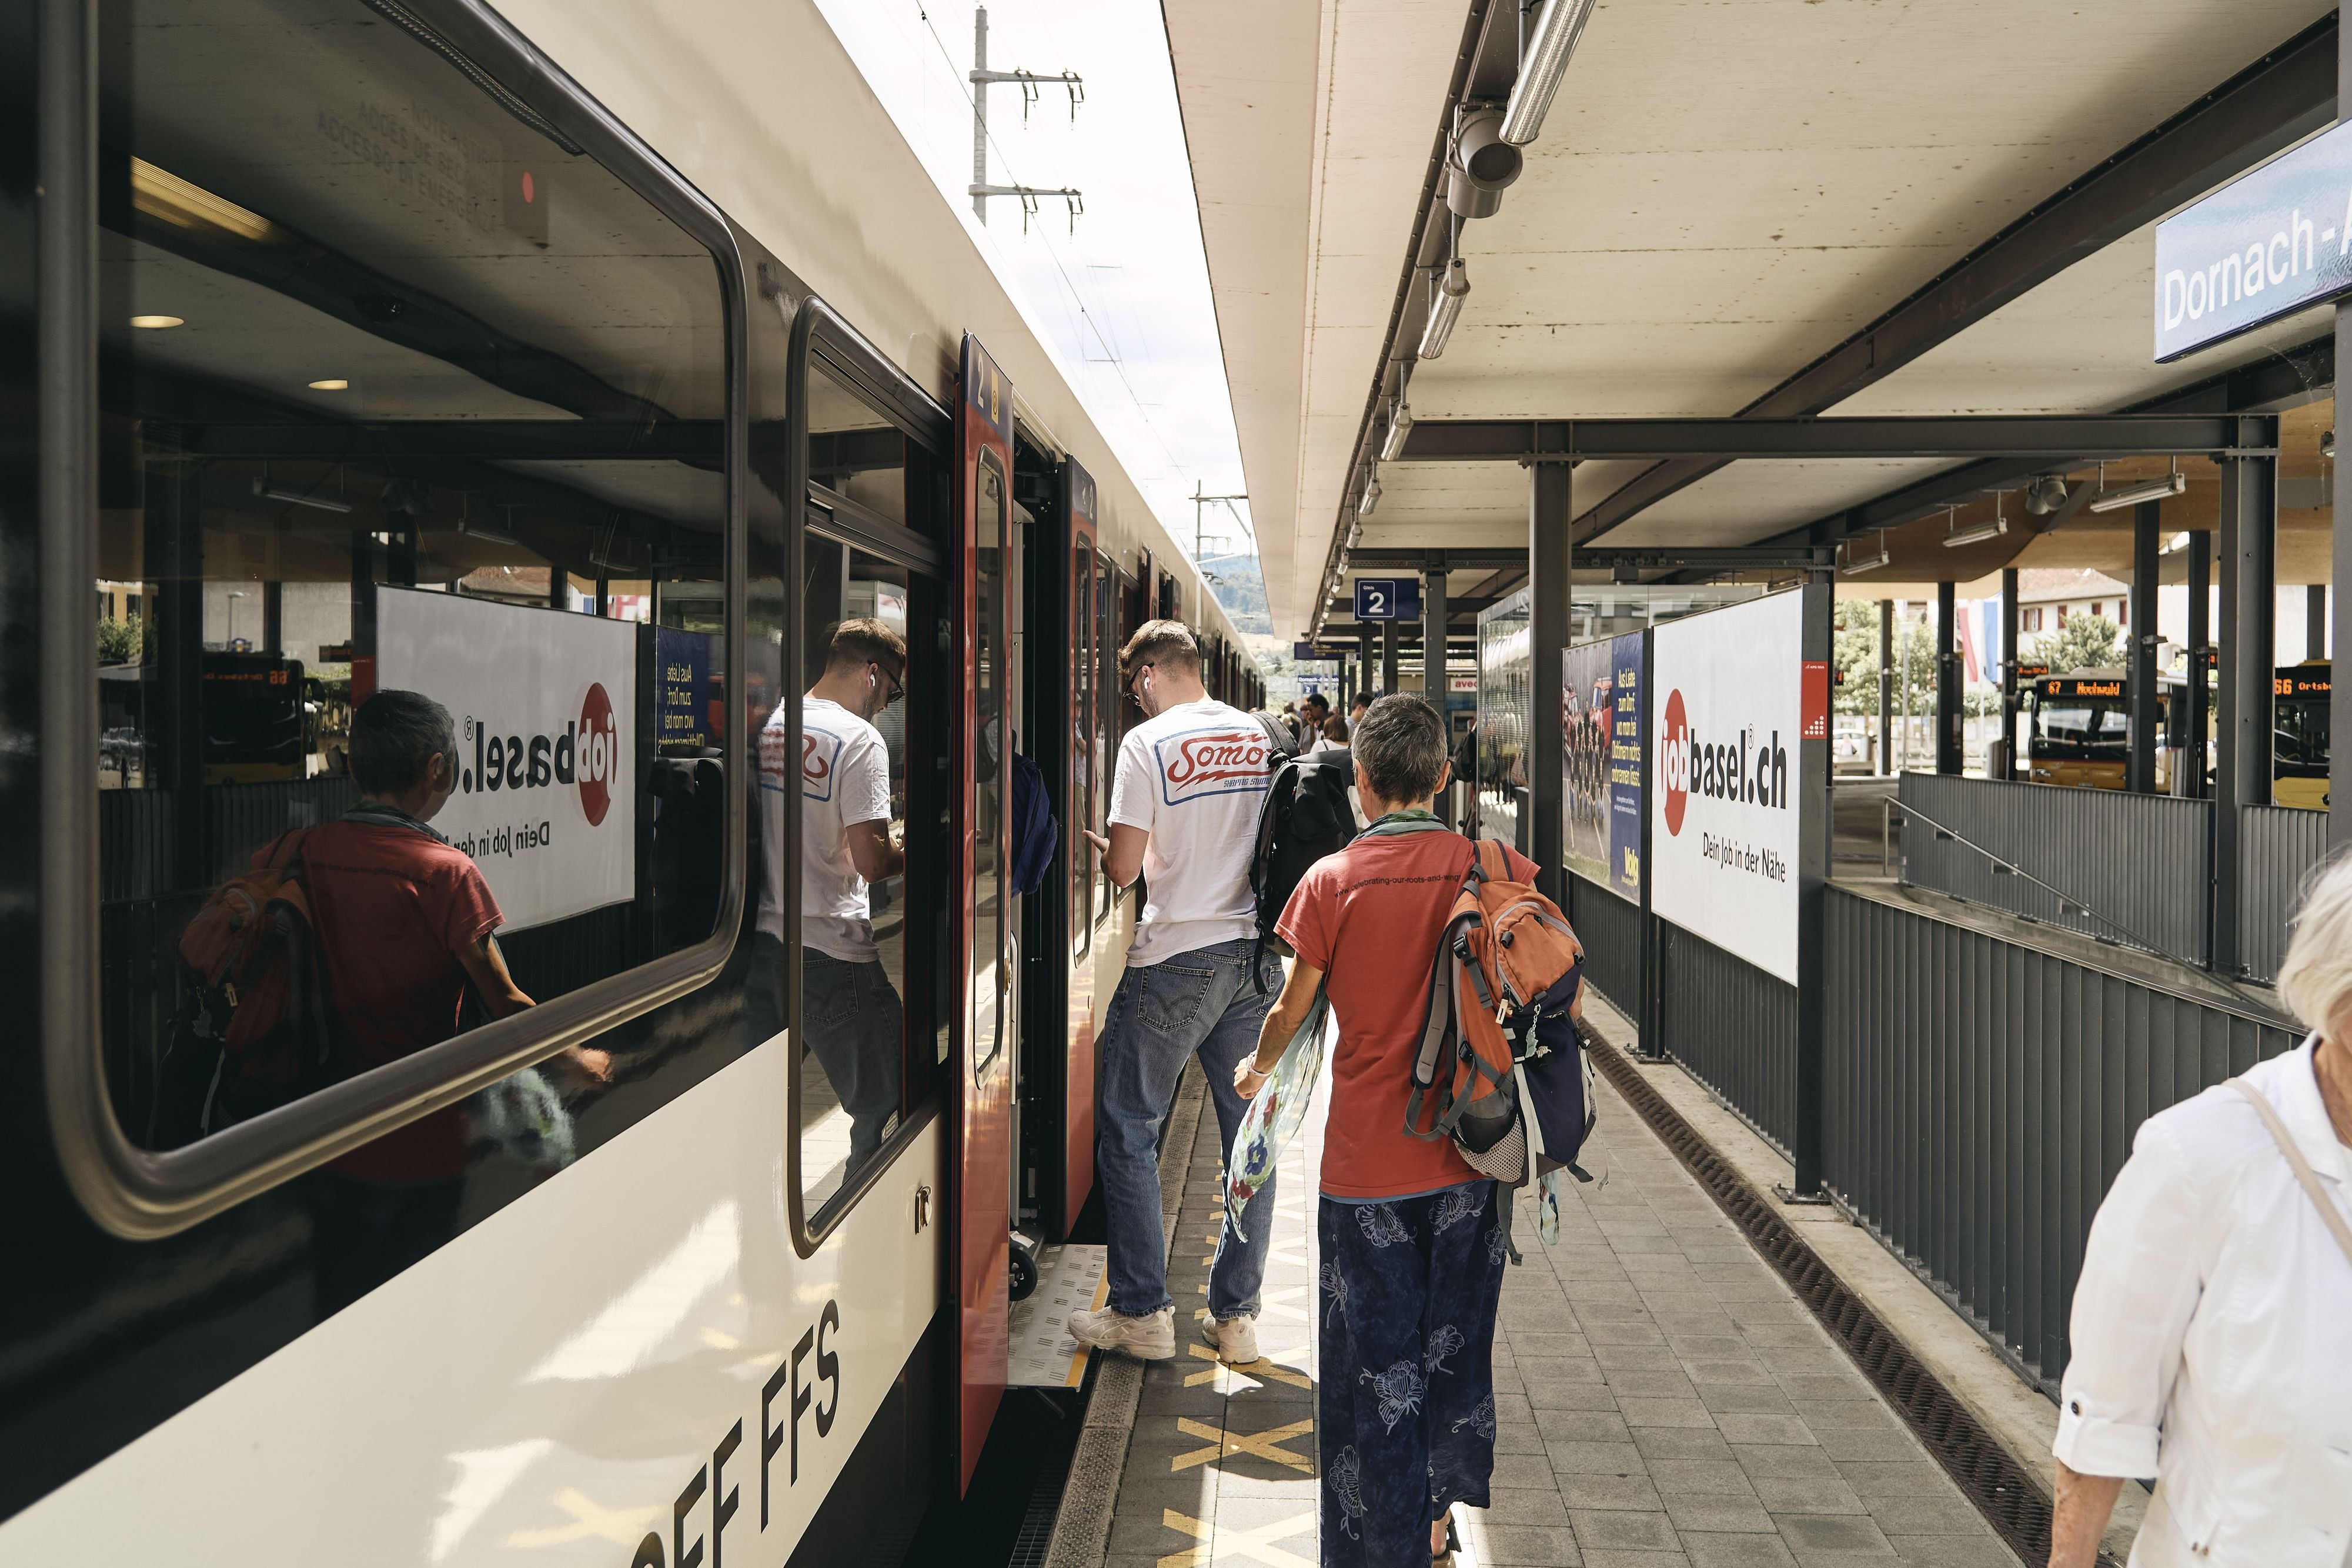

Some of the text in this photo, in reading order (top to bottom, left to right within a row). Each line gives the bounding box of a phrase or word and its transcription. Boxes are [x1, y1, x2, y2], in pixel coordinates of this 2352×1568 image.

[318, 105, 393, 174] ACCESSO
[2164, 185, 2352, 332] Dornach-
[978, 352, 984, 409] 2
[1089, 484, 1093, 520] 2
[1369, 591, 1384, 613] 2
[1625, 667, 1635, 687] Liebe
[2048, 681, 2061, 695] 67
[2274, 678, 2292, 695] 66
[1616, 721, 1622, 735] wo
[1622, 721, 1631, 736] man
[1624, 845, 1639, 886] Volg
[1703, 831, 1786, 883] Dein Job in der Nähe
[760, 1299, 840, 1534] FFS
